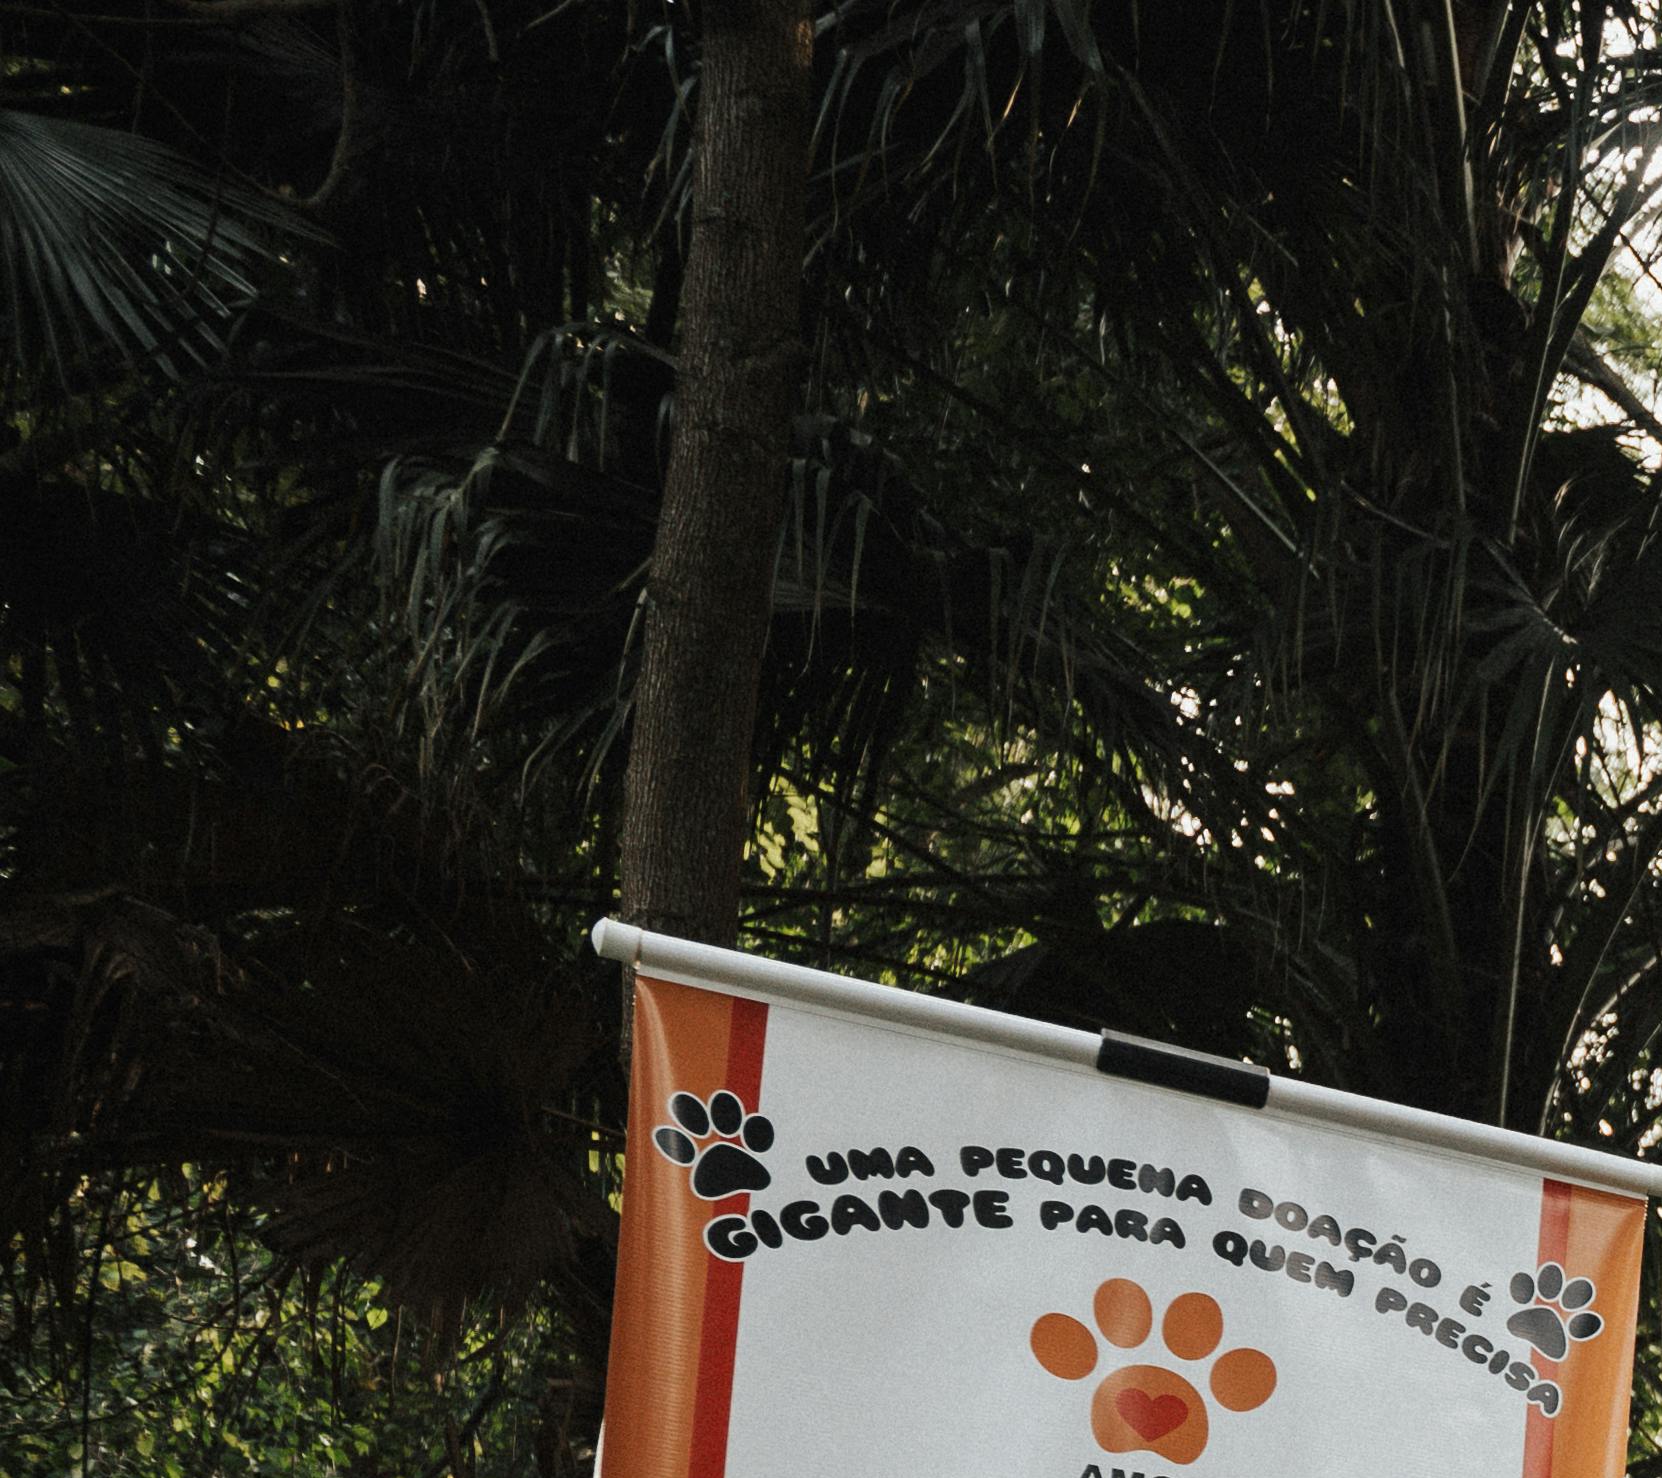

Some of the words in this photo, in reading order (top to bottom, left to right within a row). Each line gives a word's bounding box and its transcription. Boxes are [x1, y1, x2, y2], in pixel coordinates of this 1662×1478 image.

[705, 1188, 1014, 1260] GIGANTE
[1040, 1200, 1187, 1249] PARA
[1212, 1230, 1355, 1298] QUEM
[1375, 1287, 1561, 1417] PRECISA
[805, 1146, 935, 1185] UMA
[960, 1145, 1213, 1206] PEQUENA
[1238, 1188, 1442, 1288] DOAÇÃO
[1459, 1281, 1492, 1317] É
